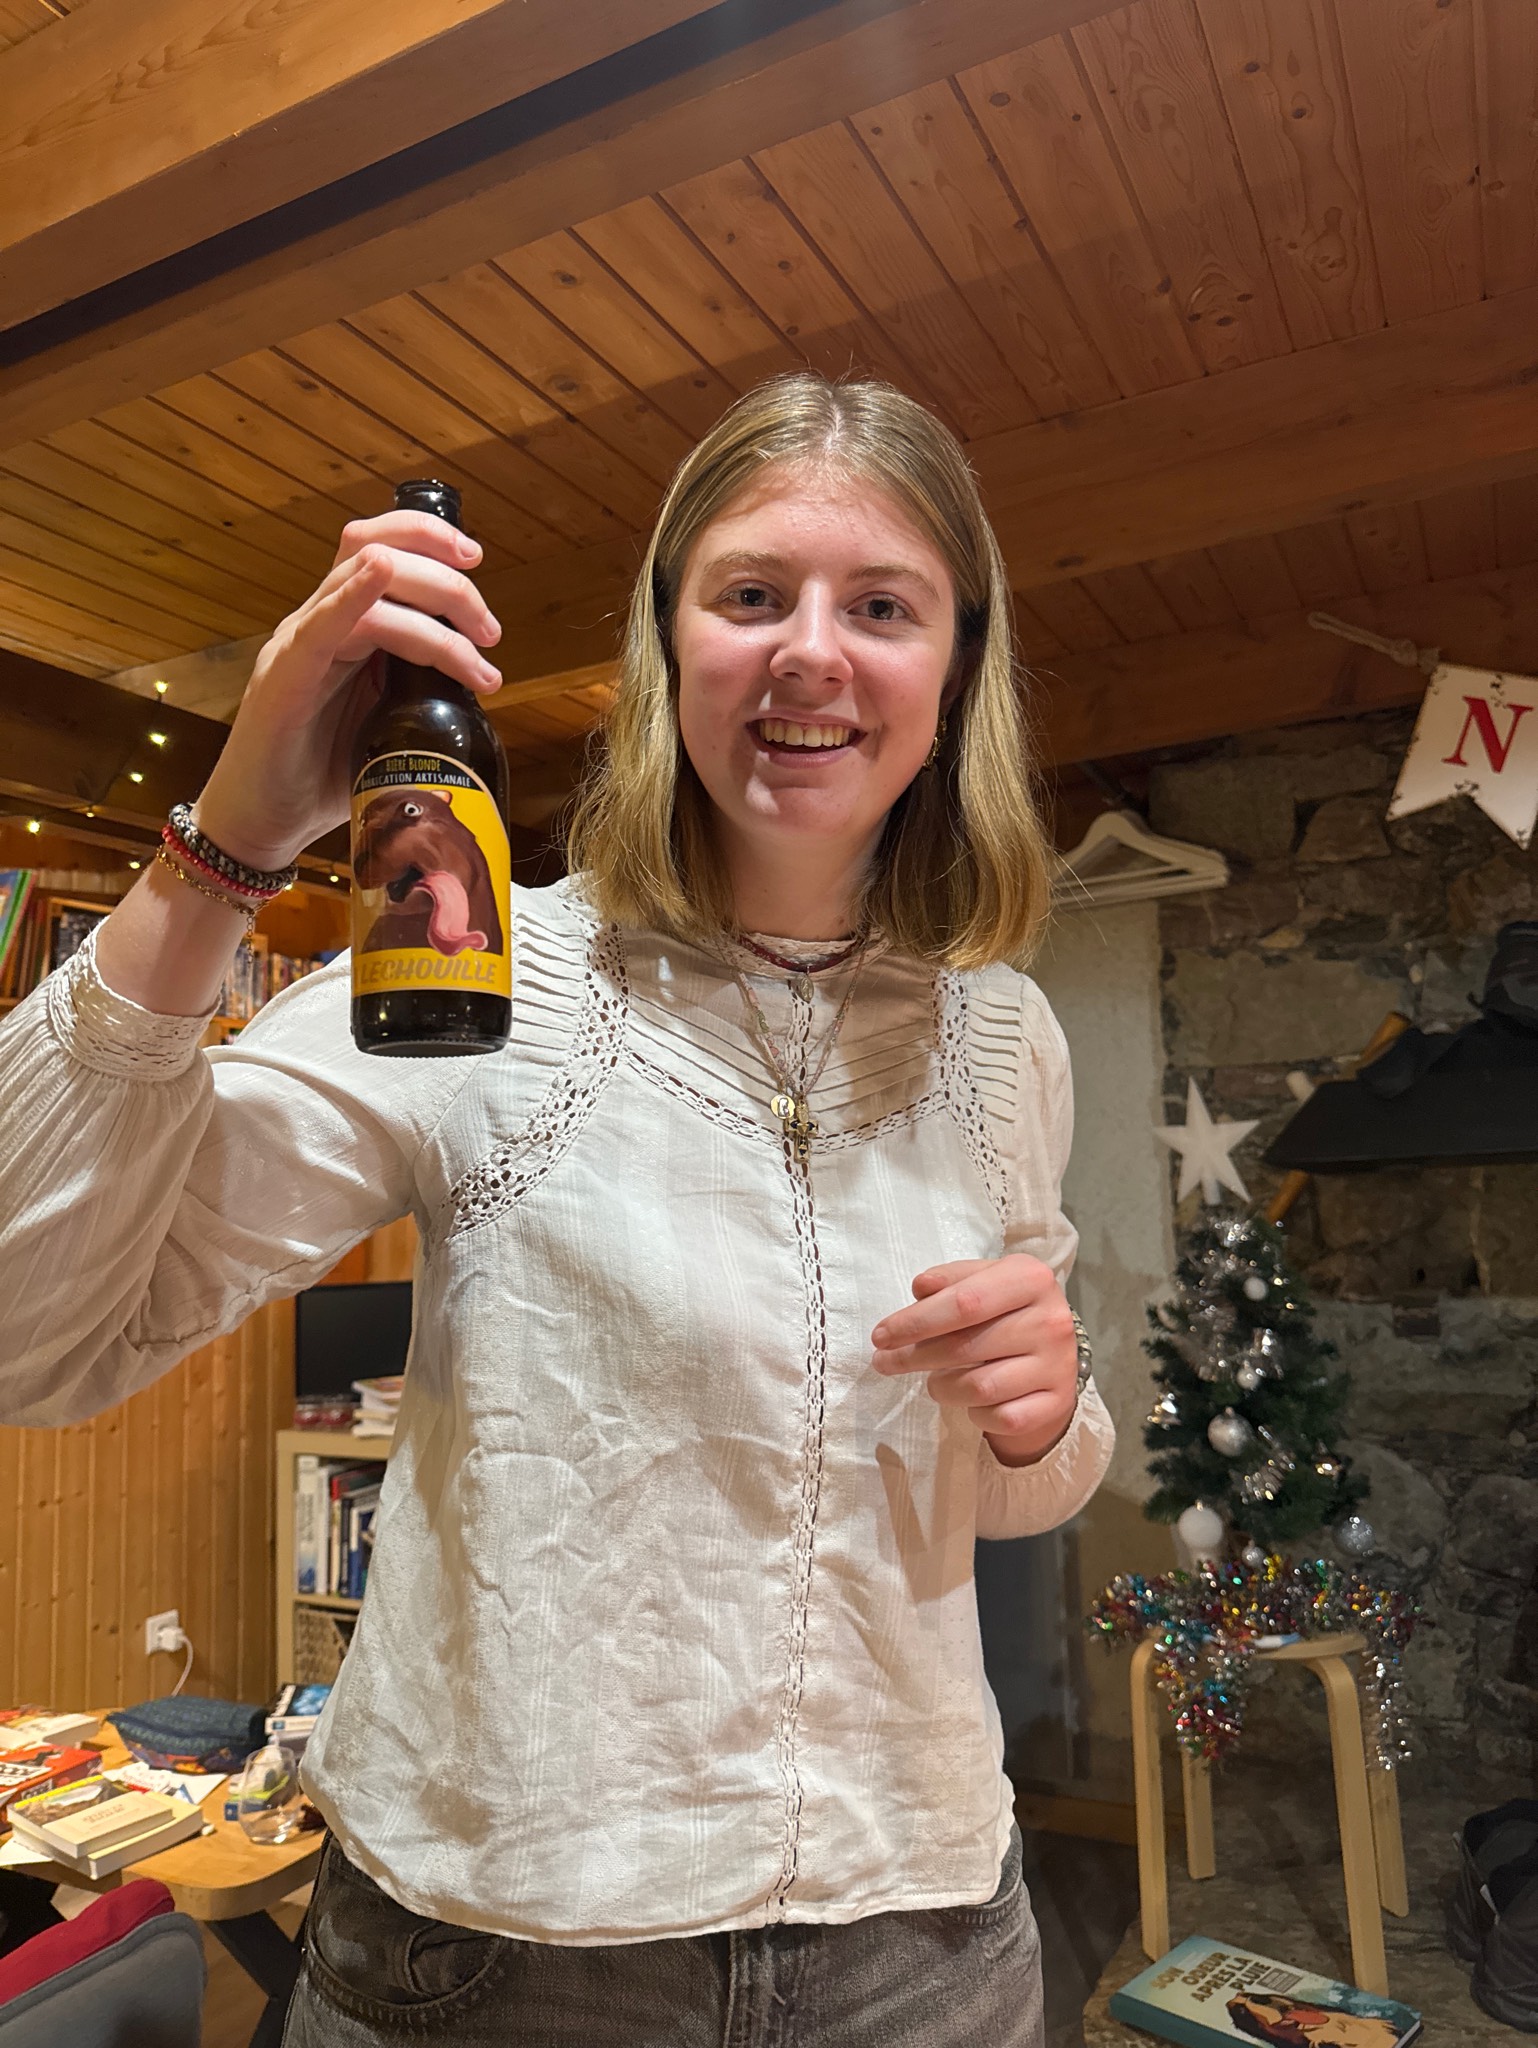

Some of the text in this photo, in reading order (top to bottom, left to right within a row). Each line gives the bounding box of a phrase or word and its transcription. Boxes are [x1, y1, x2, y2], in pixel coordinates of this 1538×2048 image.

[1441, 695, 1533, 774] N
[409, 757, 441, 771] BLONDE
[415, 772, 471, 787] ARTISANALE
[1181, 1952, 1231, 1985] ODEUR
[1225, 1957, 1253, 1975] LA
[1228, 1962, 1271, 1992] PLUIE
